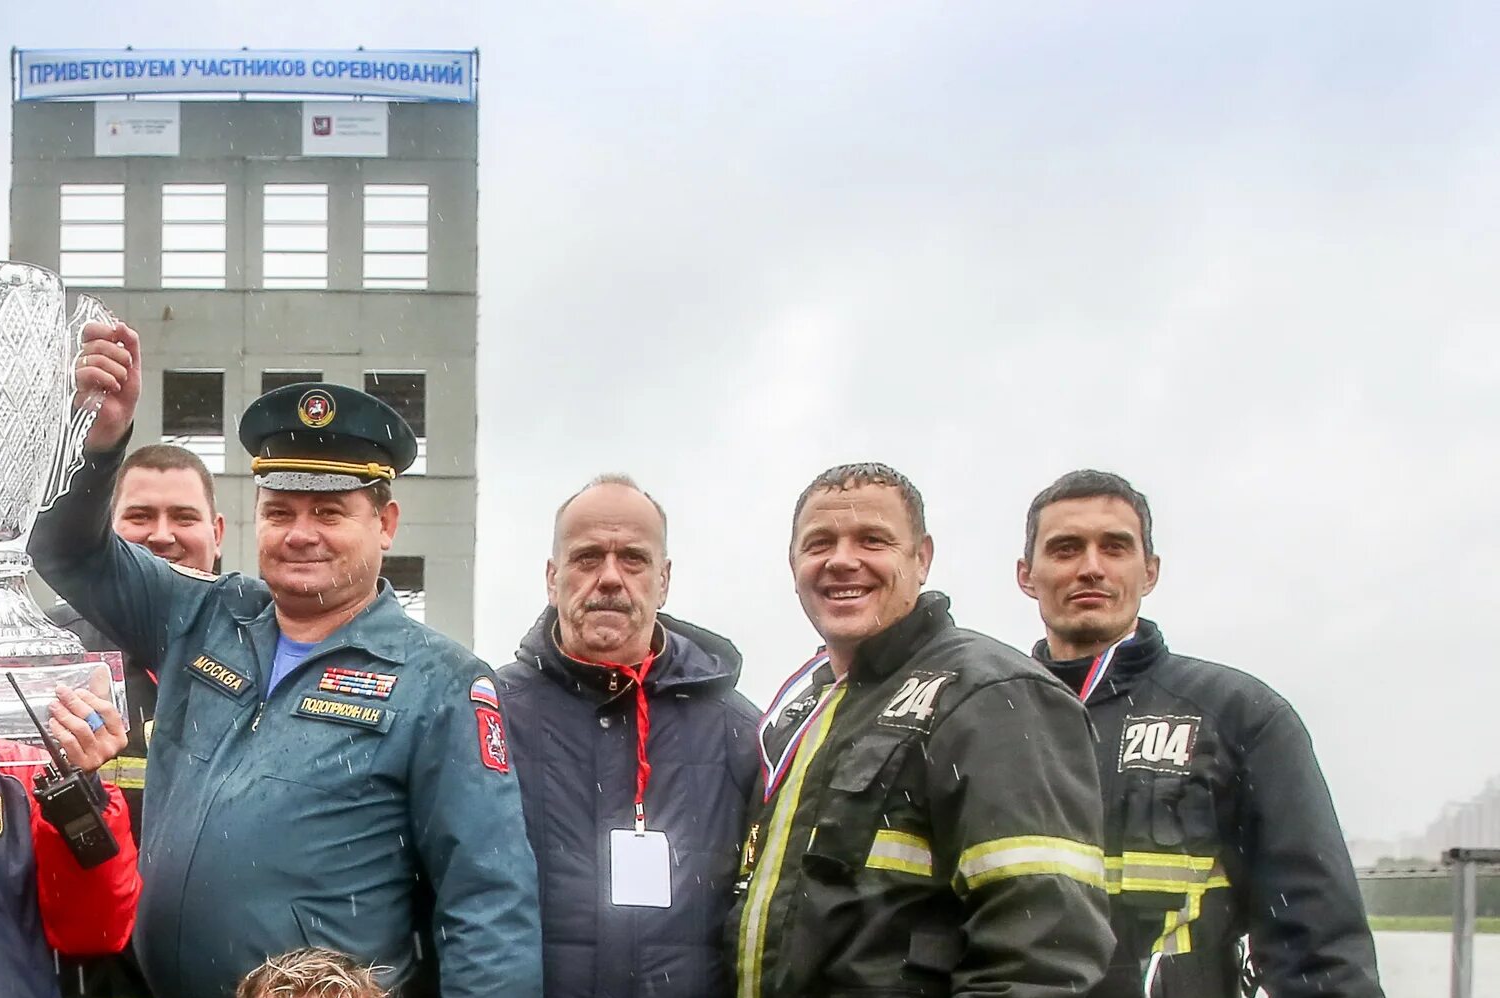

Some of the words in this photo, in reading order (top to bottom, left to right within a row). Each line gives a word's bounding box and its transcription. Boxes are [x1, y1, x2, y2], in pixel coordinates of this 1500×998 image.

[29, 59, 175, 84] ПРИВЕТСТВУЕМ
[182, 59, 306, 77] УЧАСТНИКОВ
[312, 59, 463, 85] СОРЕВНОВАНИЙ
[193, 656, 243, 691] МОСКВА
[301, 697, 362, 718] ПОДОПРИХИН
[1122, 721, 1191, 766] 204
